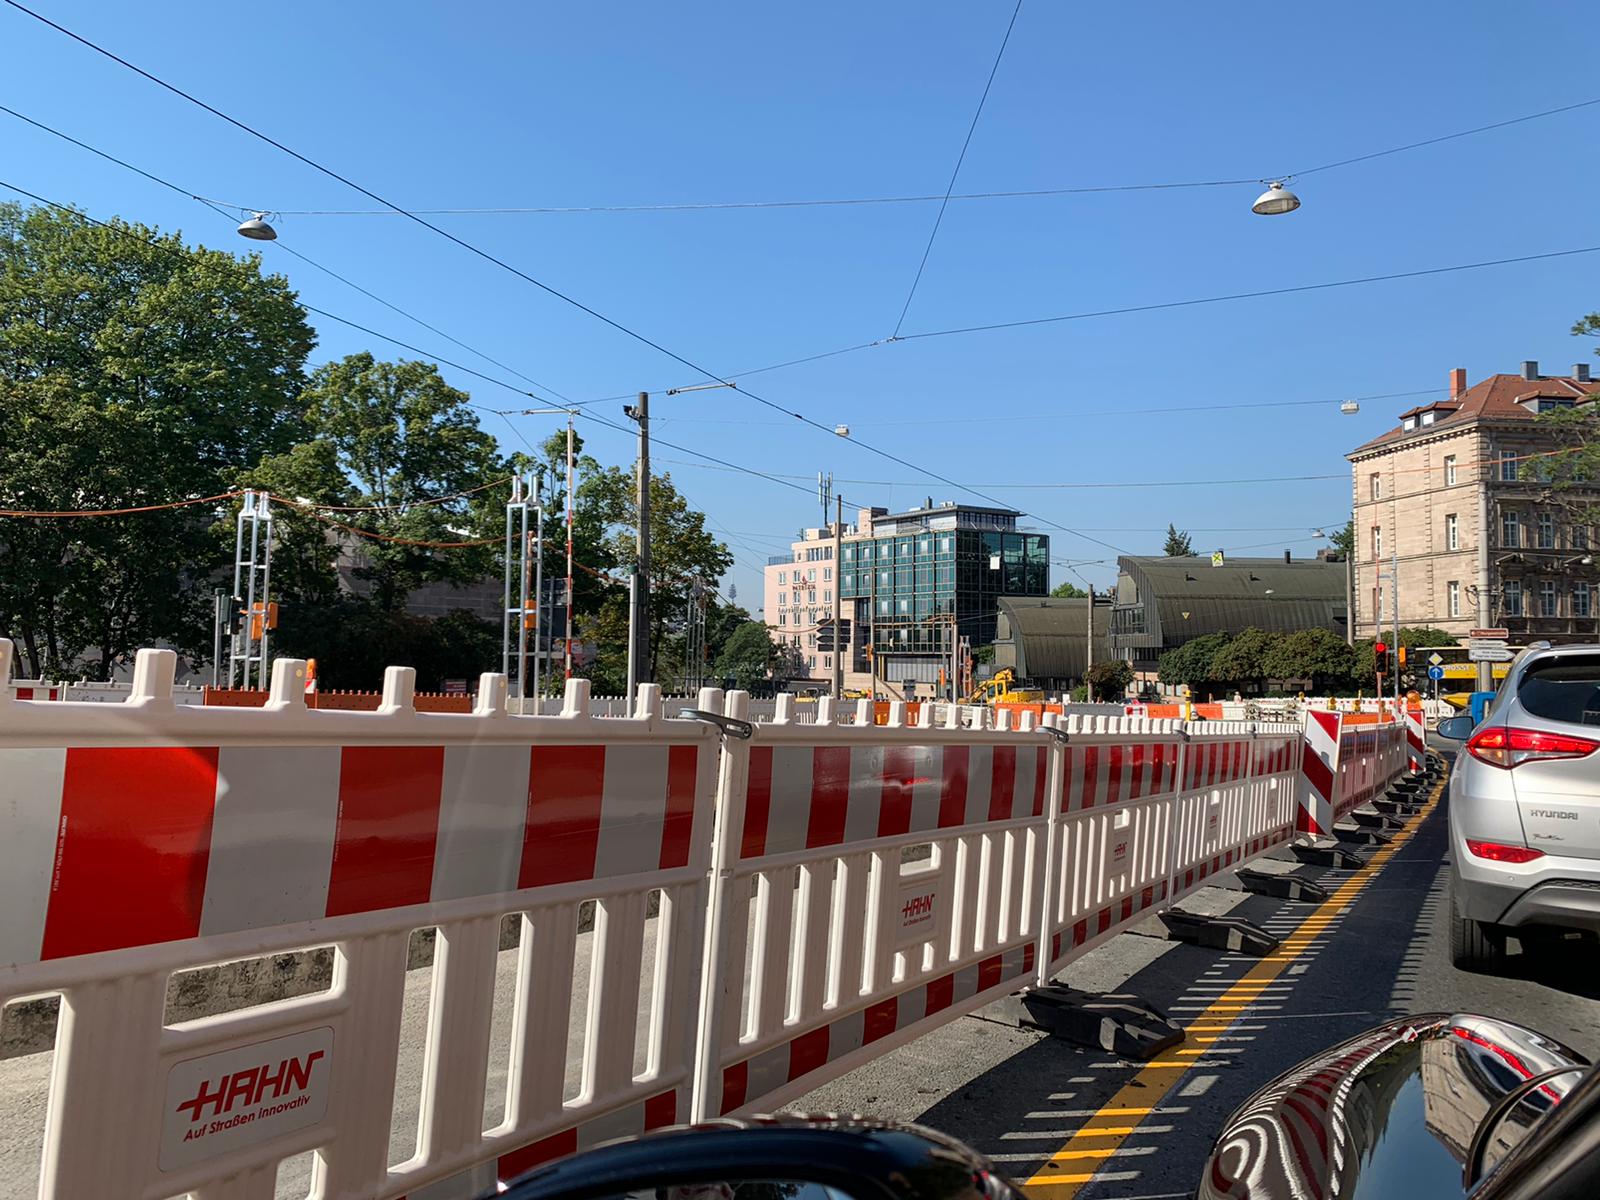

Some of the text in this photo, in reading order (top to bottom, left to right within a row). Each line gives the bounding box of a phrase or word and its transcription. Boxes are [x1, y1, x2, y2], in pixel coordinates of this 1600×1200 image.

[1530, 809, 1578, 820] HYUNDAI
[902, 893, 935, 919] HAHN
[176, 1050, 324, 1122] HAHN
[183, 1095, 311, 1142] Auf Straßen innovativ
